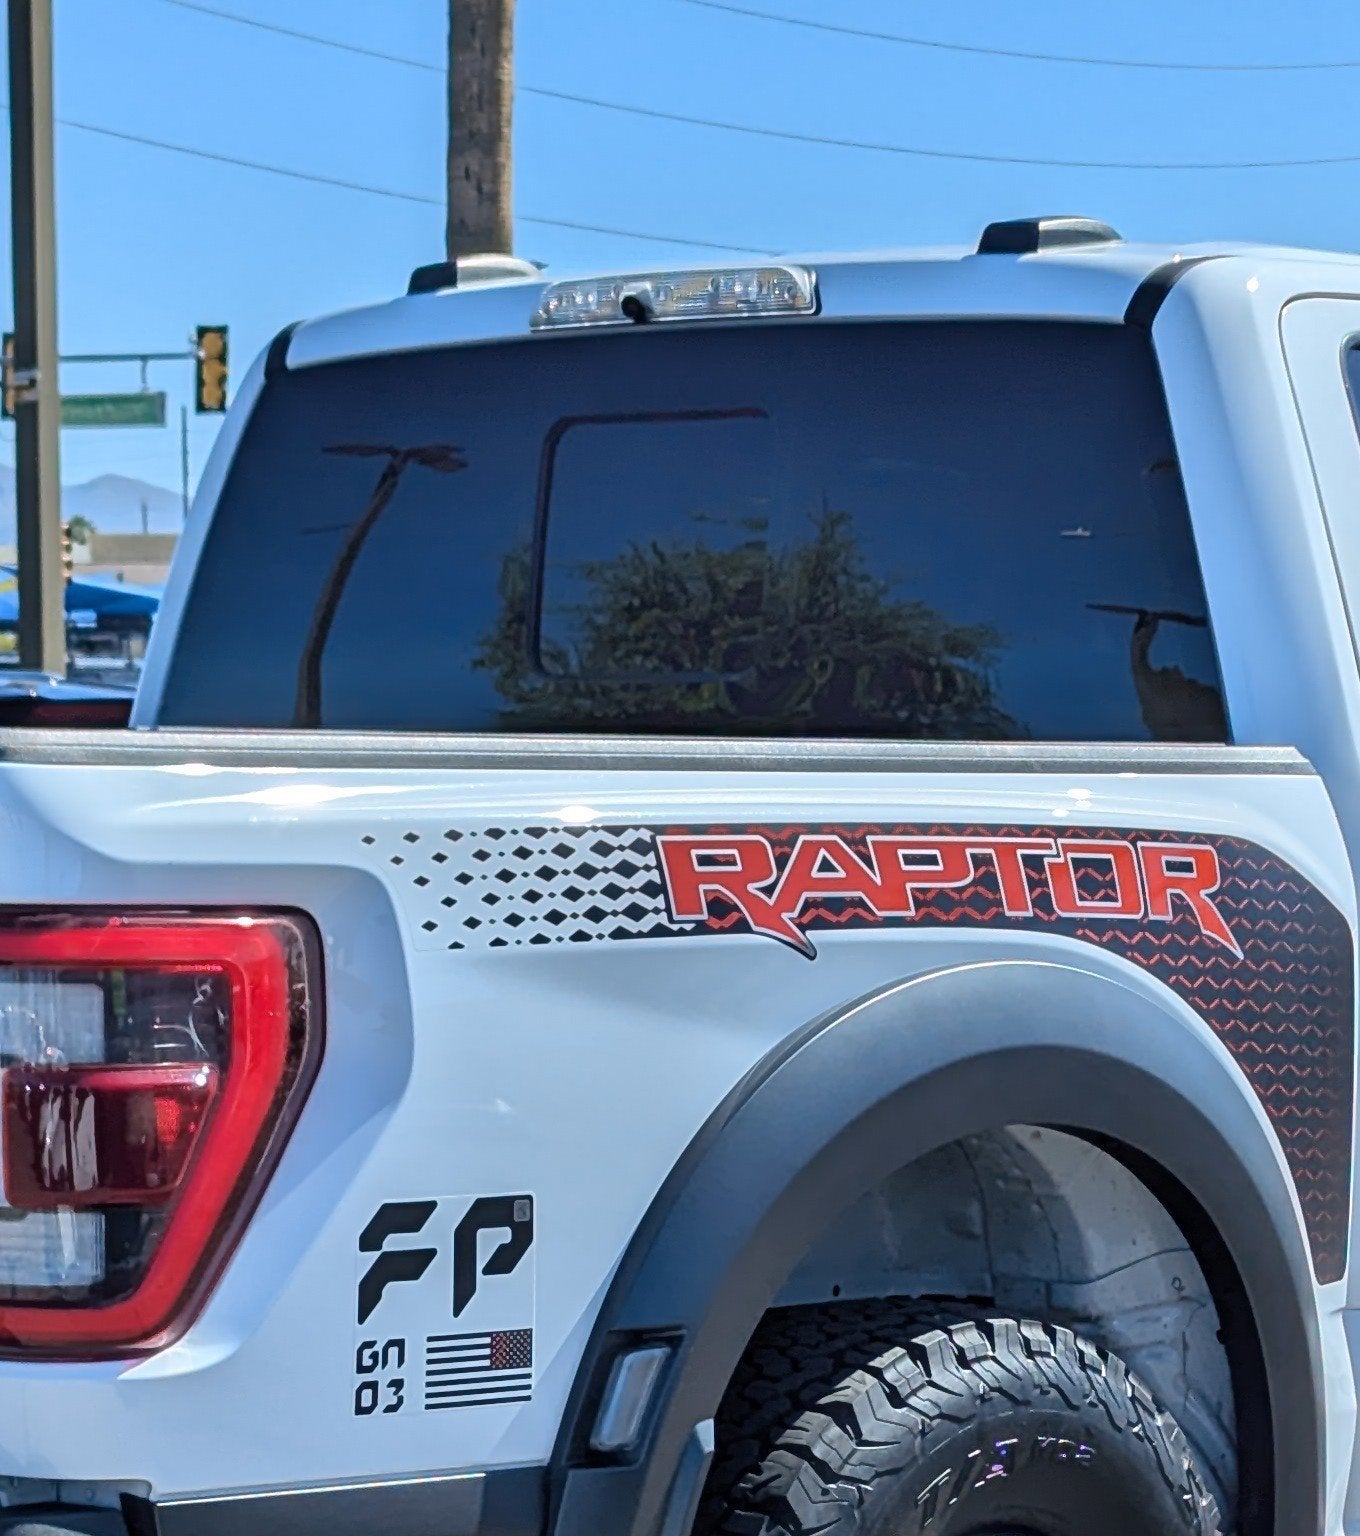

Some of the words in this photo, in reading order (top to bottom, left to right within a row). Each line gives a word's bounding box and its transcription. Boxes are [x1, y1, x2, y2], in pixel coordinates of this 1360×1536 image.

[655, 833, 1244, 960] RAPTOR
[357, 1194, 534, 1326] FP
[354, 1377, 405, 1416] 03
